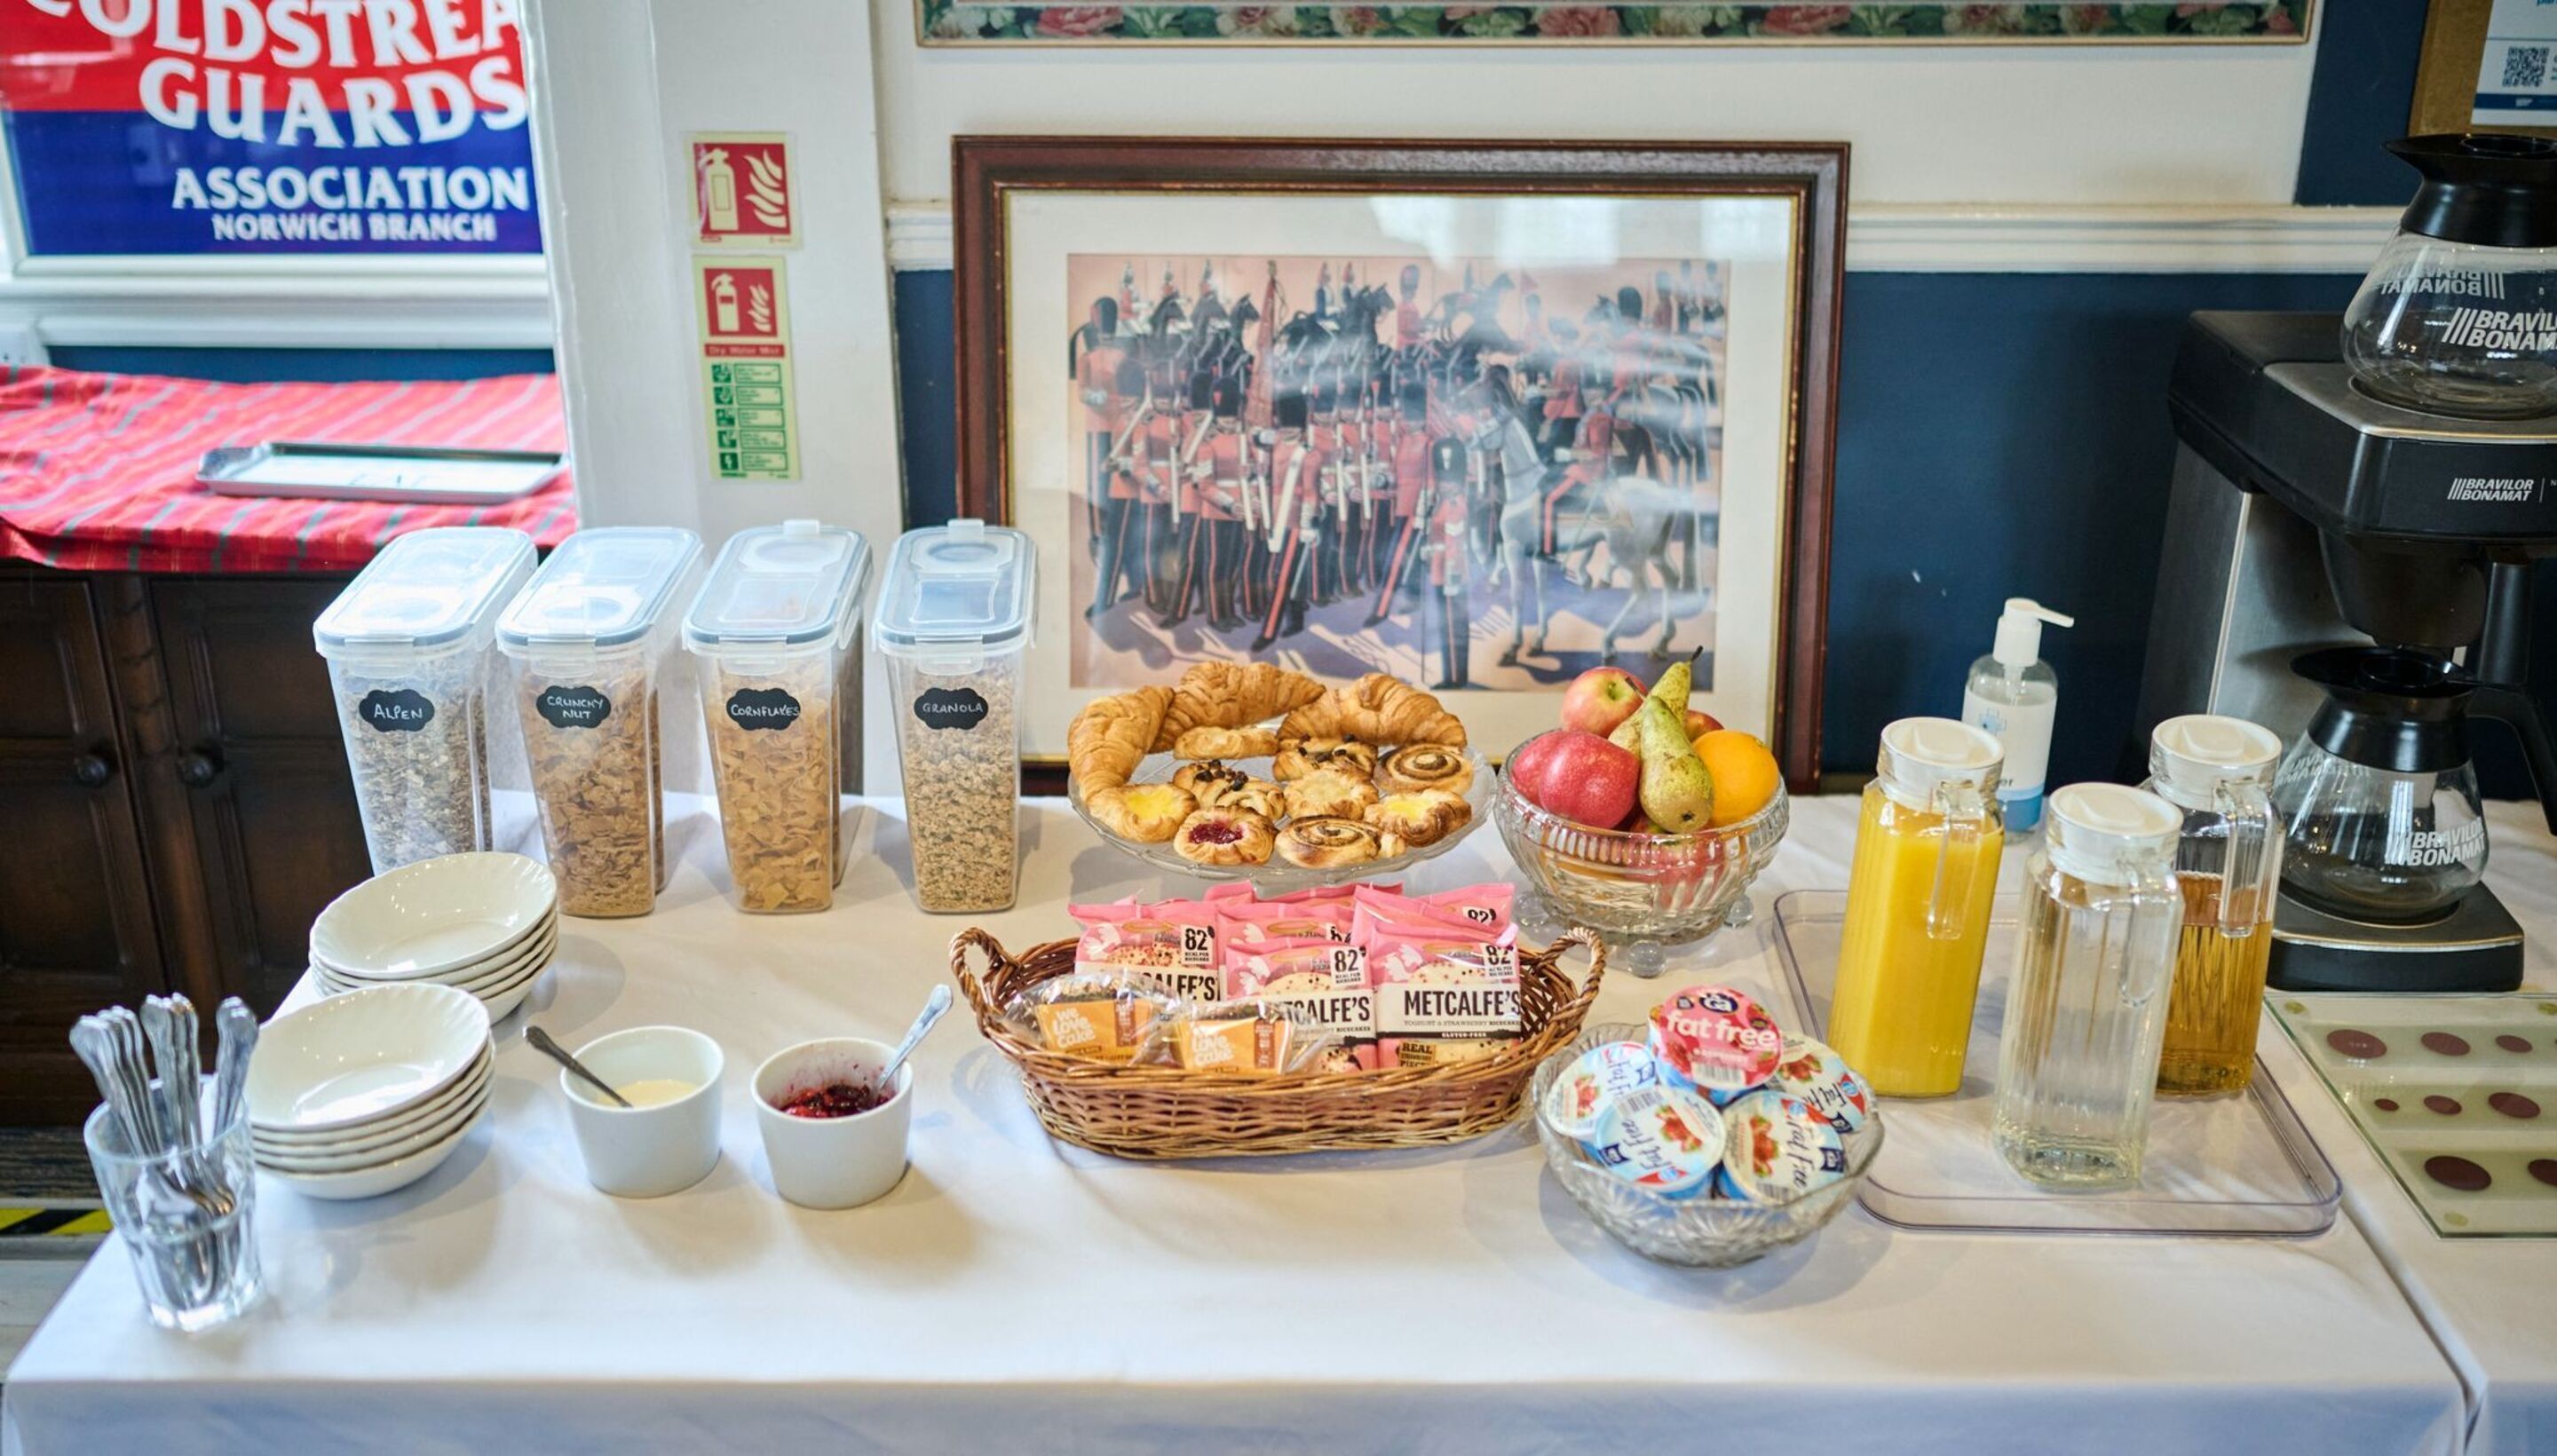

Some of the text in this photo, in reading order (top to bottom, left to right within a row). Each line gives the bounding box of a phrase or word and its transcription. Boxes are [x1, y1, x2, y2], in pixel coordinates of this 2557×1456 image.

[32, 0, 522, 69] OLDSTREA
[139, 55, 529, 149] GUARDS
[172, 166, 530, 210] ASSOCIATION
[211, 213, 497, 241] NORWICH BRANCH
[2474, 309, 2557, 331] BRAVIL
[2466, 328, 2557, 351] BONAM
[2461, 489, 2532, 502] BONAMAT
[2466, 479, 2534, 490] BRAVILOR
[374, 704, 423, 720] ALPEN
[562, 709, 592, 720] NUT
[731, 704, 800, 716] CORNFLAKES
[922, 702, 984, 714] GRANOLA
[1185, 928, 1207, 951] 82
[1334, 949, 1358, 972] 82
[1486, 946, 1513, 965] 82
[1404, 990, 1521, 1017] METCALFE'S
[1667, 1010, 1711, 1039] fat
[1716, 1018, 1777, 1048] free
[1402, 1042, 1433, 1054] REAL
